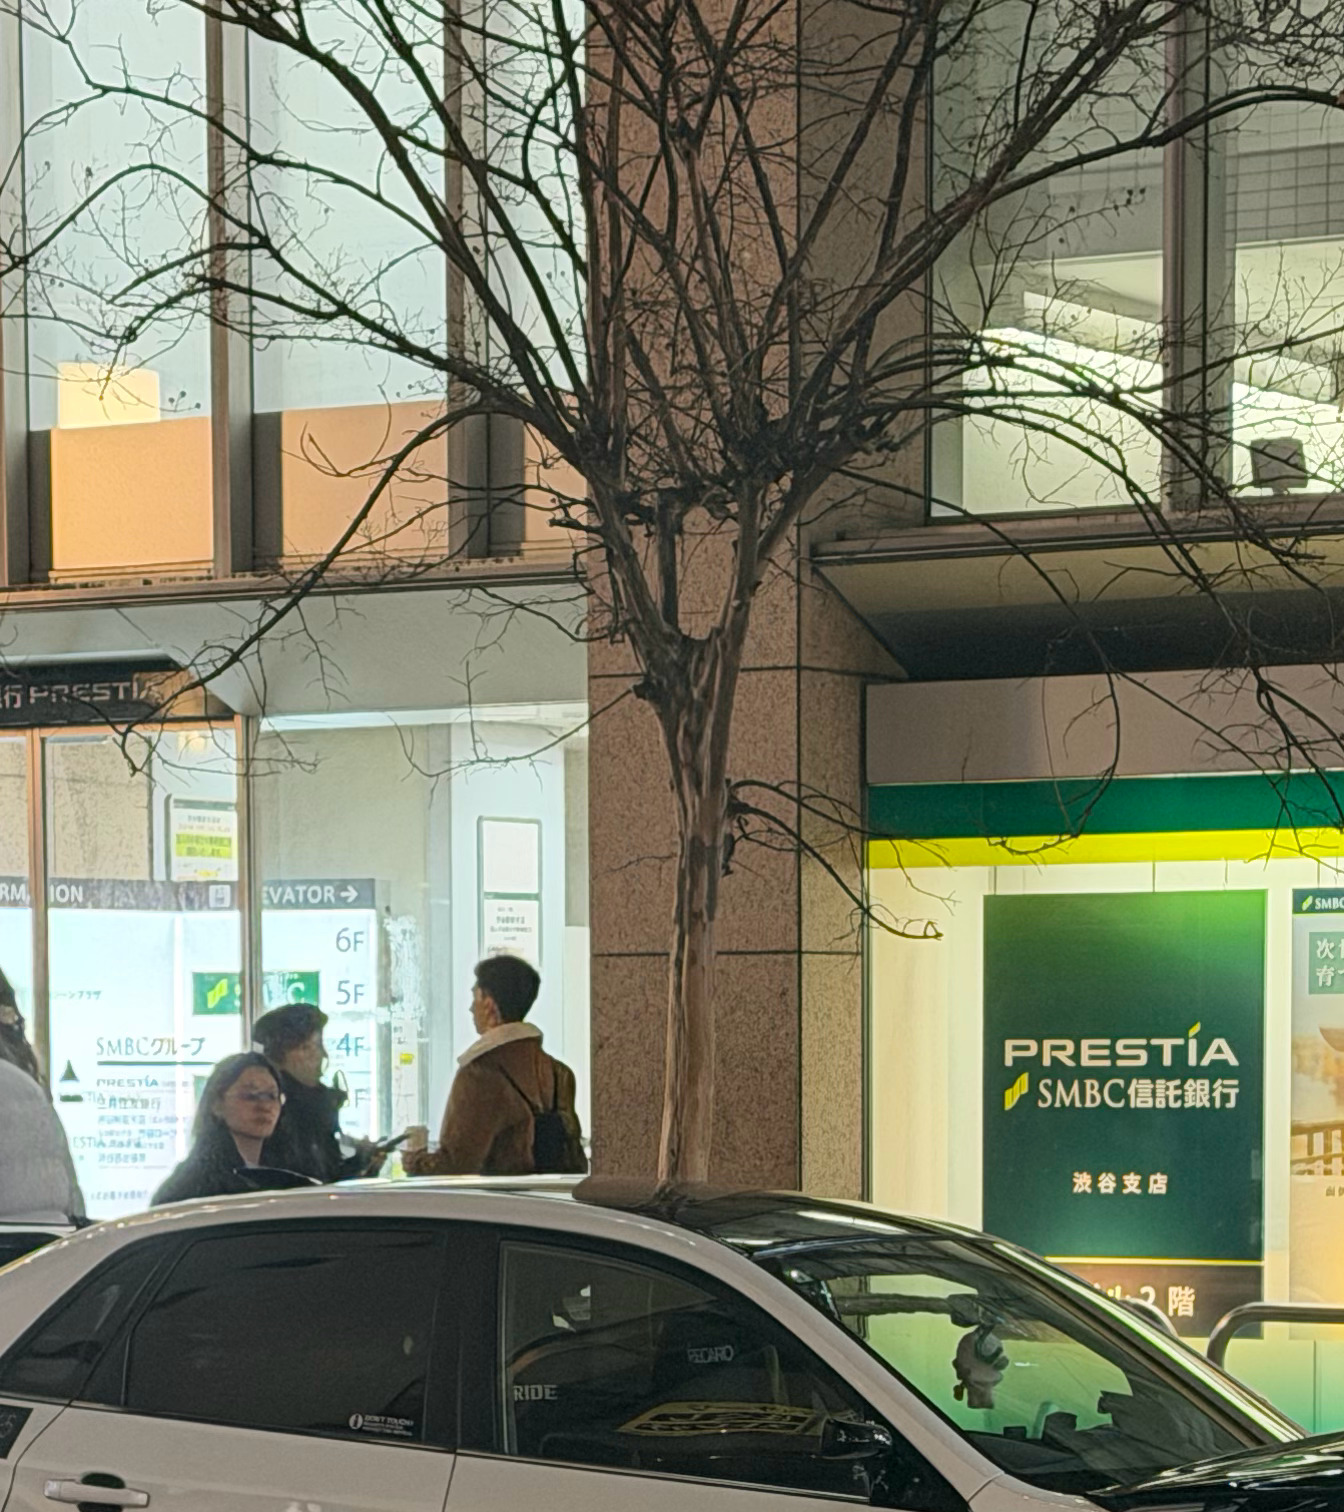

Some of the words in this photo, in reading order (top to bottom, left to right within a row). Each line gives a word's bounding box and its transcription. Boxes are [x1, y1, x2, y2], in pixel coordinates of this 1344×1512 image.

[336, 927, 365, 953] 6F
[336, 980, 366, 1005] 5F
[336, 1032, 365, 1057] 4F
[1004, 1021, 1239, 1066] PRESTÍA
[1037, 1078, 1239, 1109] SMBC信託銀行
[1072, 1171, 1168, 1194] 渋谷支店
